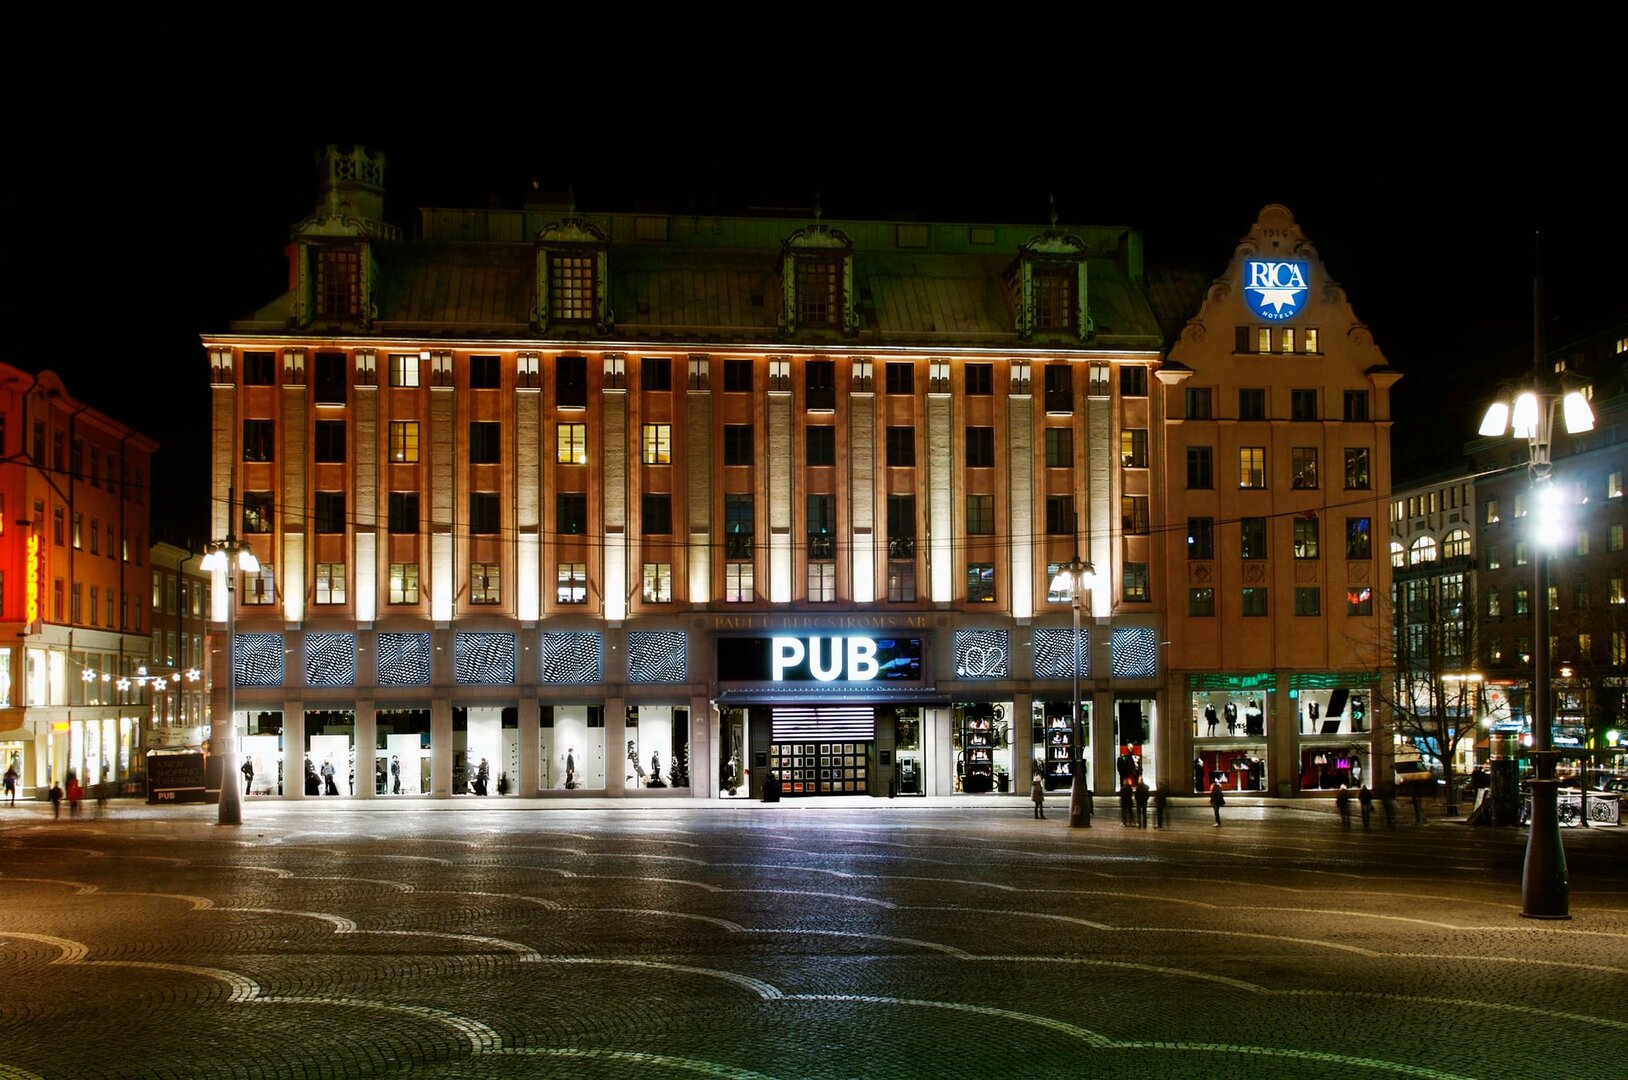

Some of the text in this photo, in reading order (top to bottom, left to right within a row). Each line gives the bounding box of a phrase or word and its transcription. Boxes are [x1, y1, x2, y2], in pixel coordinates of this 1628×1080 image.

[1249, 262, 1307, 287] RICA
[1262, 310, 1294, 319] HOTELS
[715, 616, 752, 629] PAUL
[905, 616, 926, 628] AB
[771, 636, 880, 682] PUB
[158, 792, 175, 800] PUB
